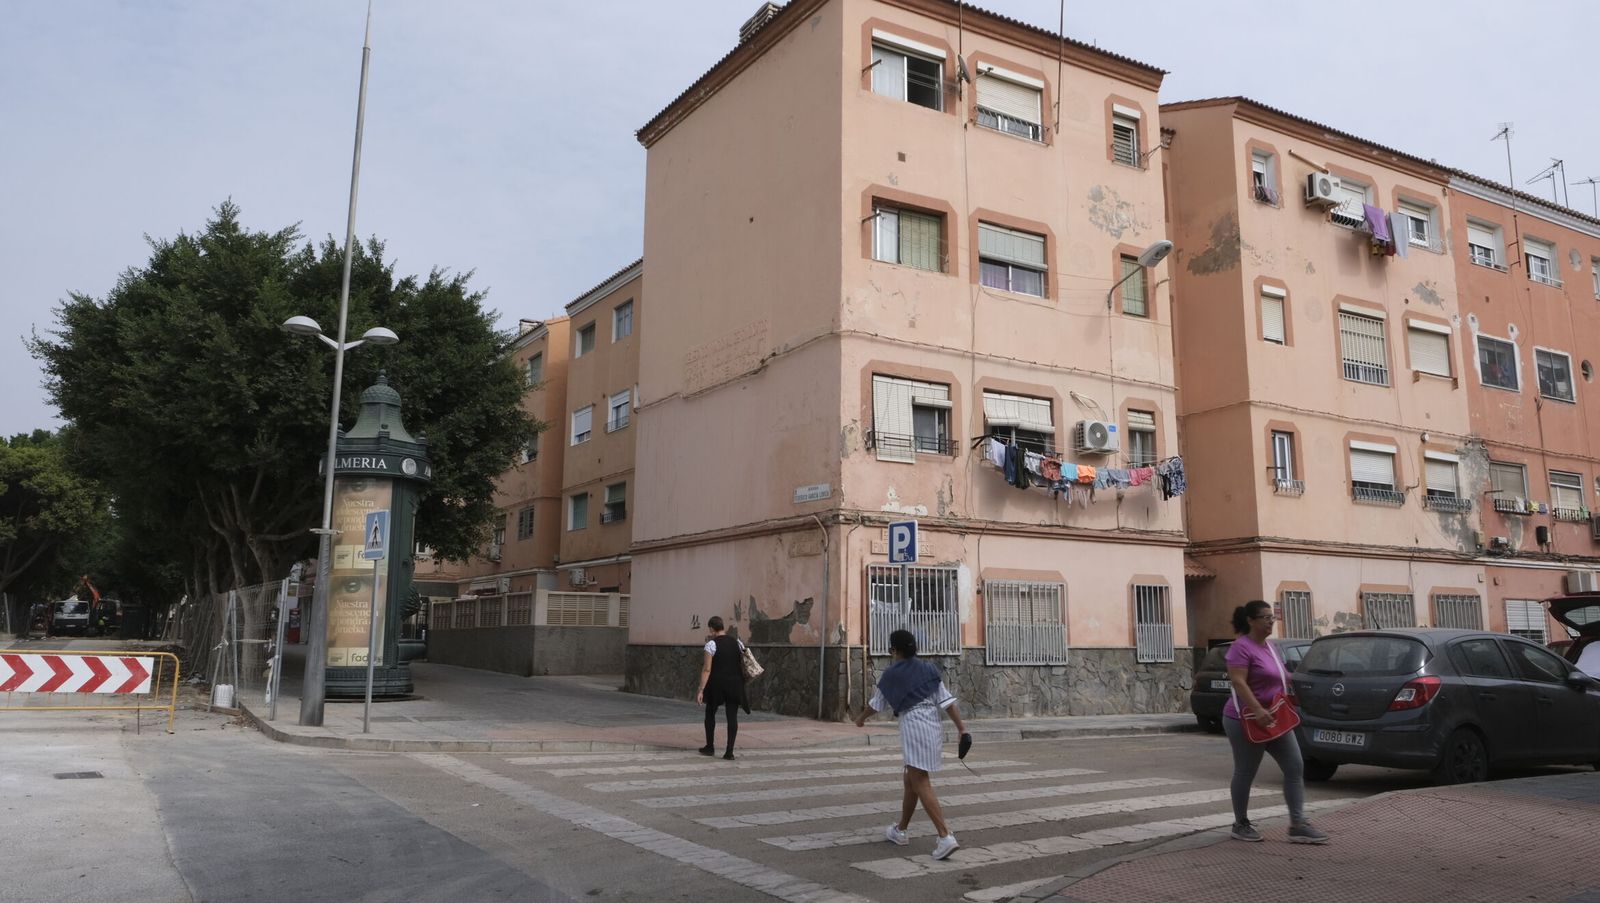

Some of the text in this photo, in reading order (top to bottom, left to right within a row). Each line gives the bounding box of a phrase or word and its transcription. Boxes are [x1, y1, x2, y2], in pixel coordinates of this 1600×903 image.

[334, 457, 387, 469] LMERIA
[893, 526, 911, 561] P
[1320, 731, 1342, 742] 0080
